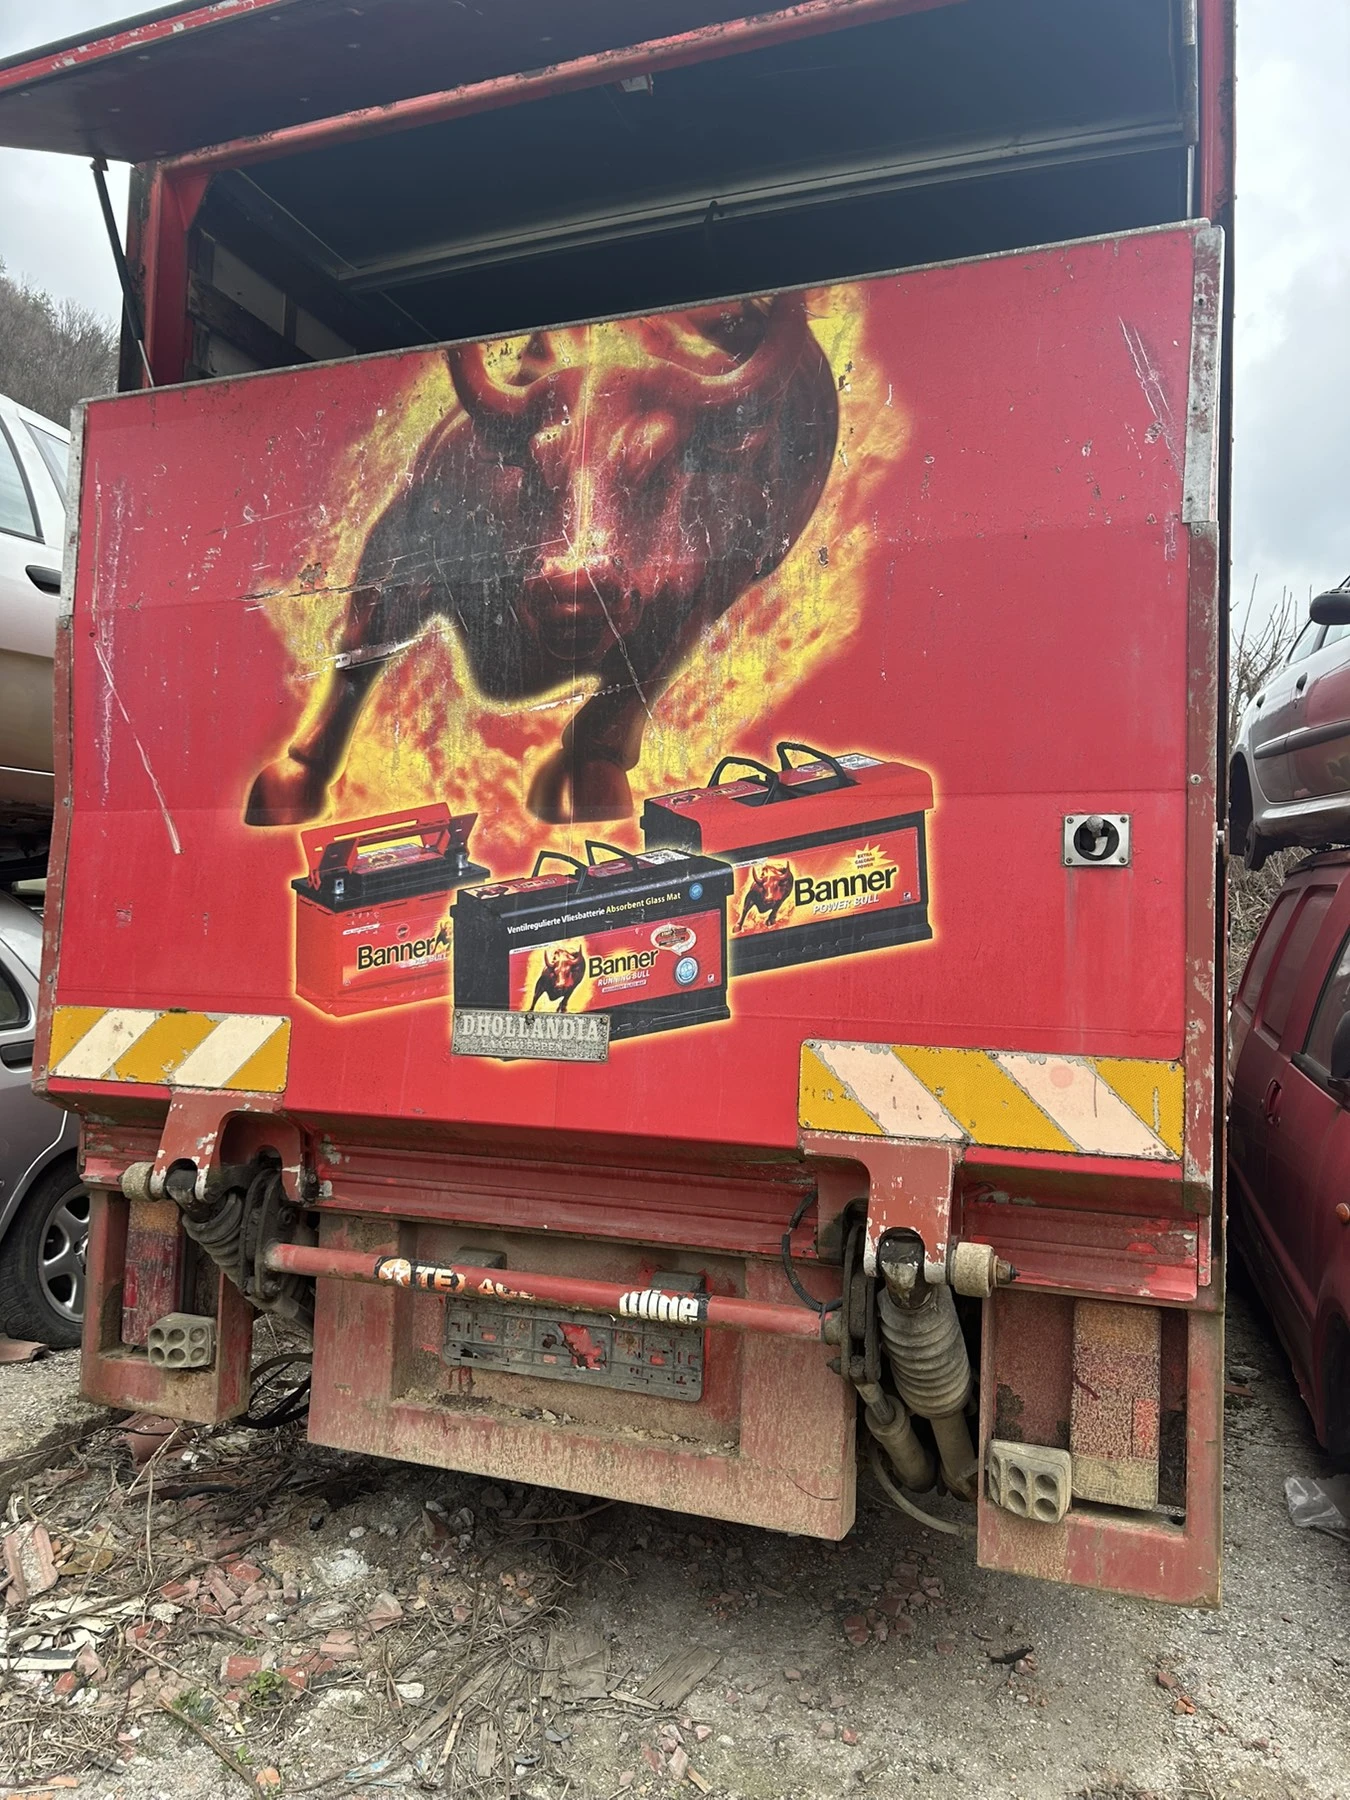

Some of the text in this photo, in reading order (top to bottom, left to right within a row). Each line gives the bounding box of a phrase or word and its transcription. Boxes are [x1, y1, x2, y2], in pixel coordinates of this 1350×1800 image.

[794, 866, 897, 907] Banner
[507, 892, 682, 934] Ventilregulierte Vliesbatterie Absorbent Glass Mat
[813, 894, 880, 915] POWER BULL
[358, 937, 436, 970] Banner
[588, 950, 659, 978] Banner
[632, 969, 651, 980] BULL
[461, 1014, 601, 1042] DHOLLANDIA
